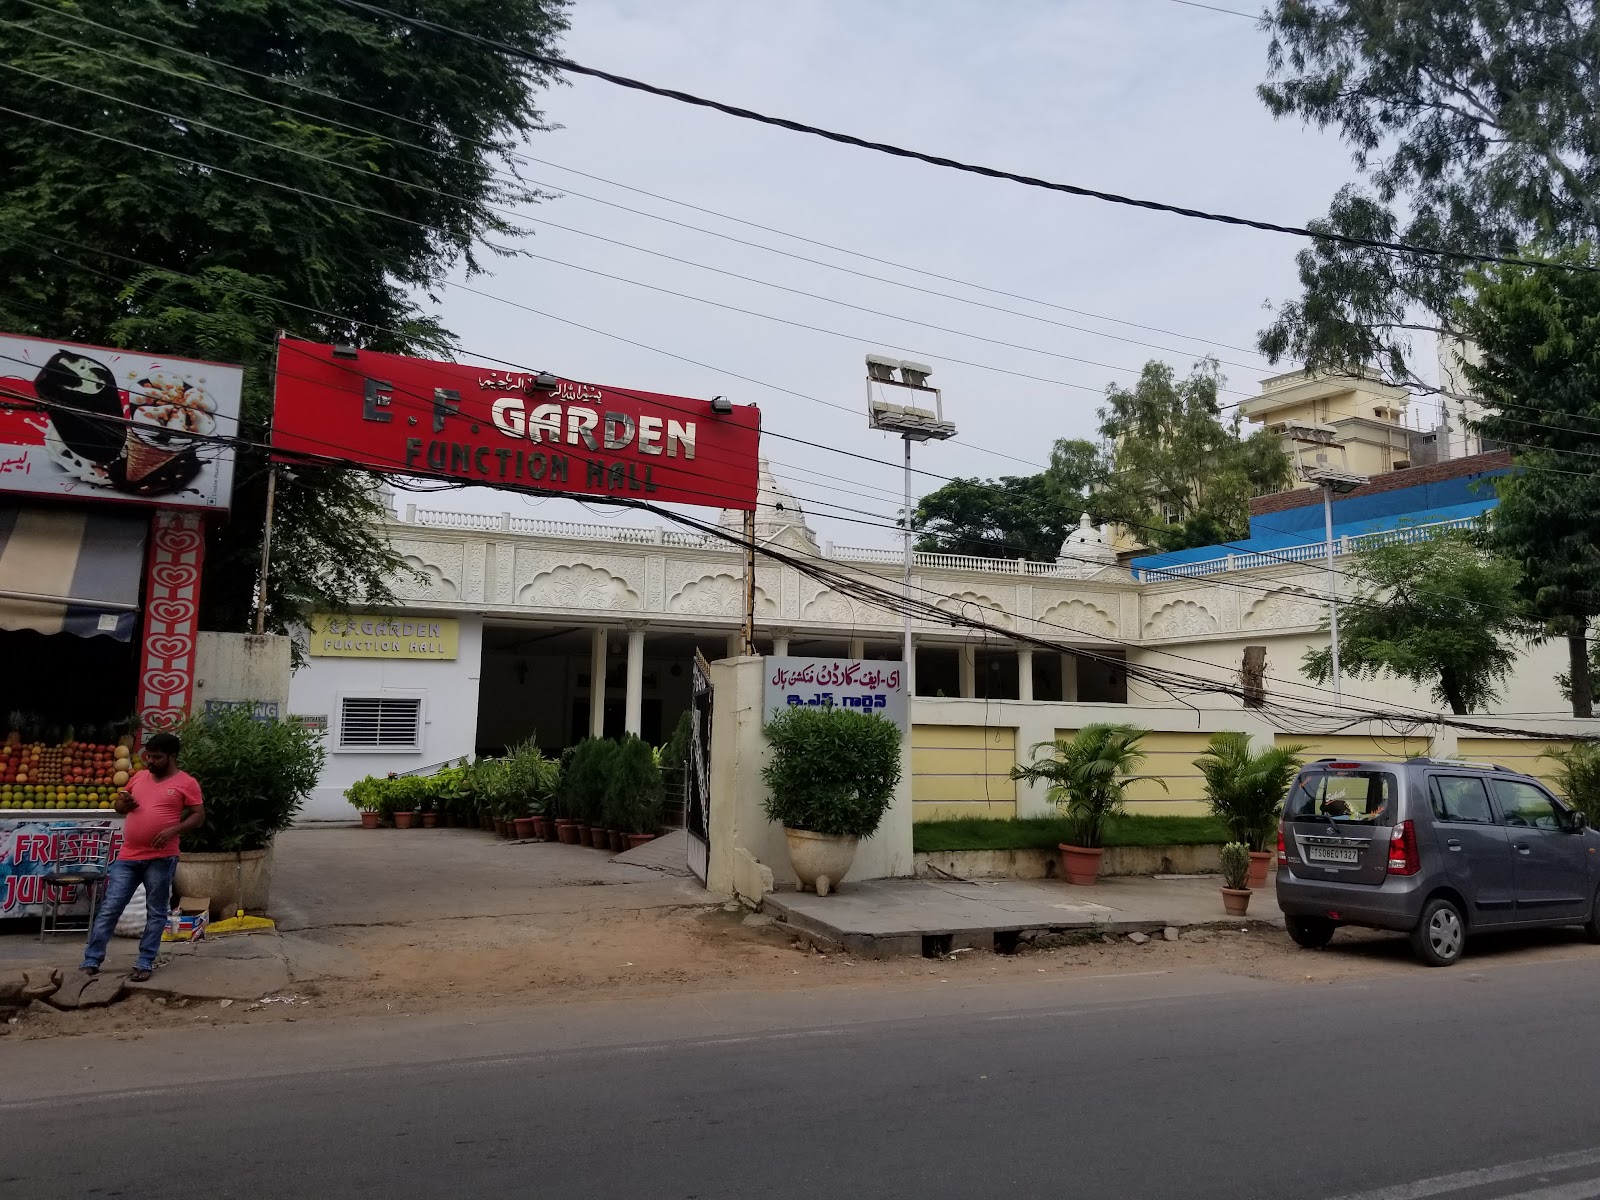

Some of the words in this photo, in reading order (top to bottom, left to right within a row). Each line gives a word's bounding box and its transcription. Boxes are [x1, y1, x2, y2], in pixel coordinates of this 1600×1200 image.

[491, 397, 697, 459] GARDEN
[405, 437, 569, 482] FUNCTION
[586, 458, 658, 492] HALL
[324, 639, 400, 652] FUNCTION
[408, 641, 445, 653] HALL
[14, 832, 101, 866] FRESH
